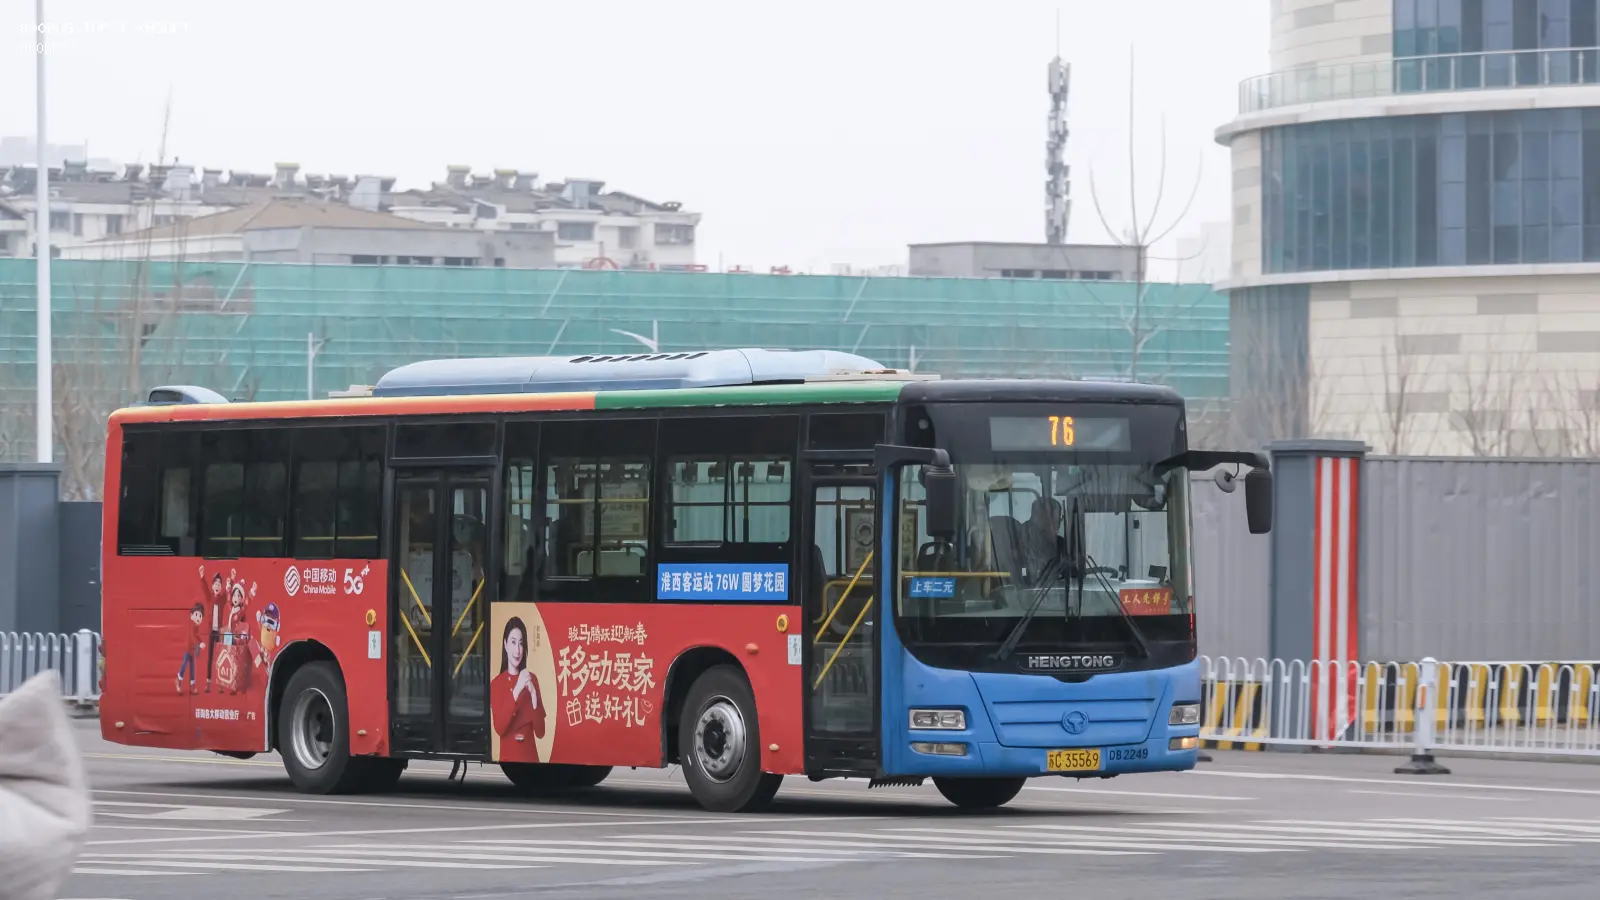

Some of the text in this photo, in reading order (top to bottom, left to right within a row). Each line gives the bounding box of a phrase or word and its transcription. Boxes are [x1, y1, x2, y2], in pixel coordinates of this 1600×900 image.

[1048, 416, 1074, 446] 76
[303, 567, 337, 583] 中国移动
[661, 572, 785, 593] 淮西客运站 76W 圆梦花园
[303, 584, 337, 594] China Mobile
[912, 580, 954, 594] 上车二元
[568, 622, 648, 646] 骏马腾跃迎新春
[558, 644, 656, 697] 移动爱家
[1028, 655, 1114, 668] HENGTONG
[584, 691, 646, 728] 送好礼
